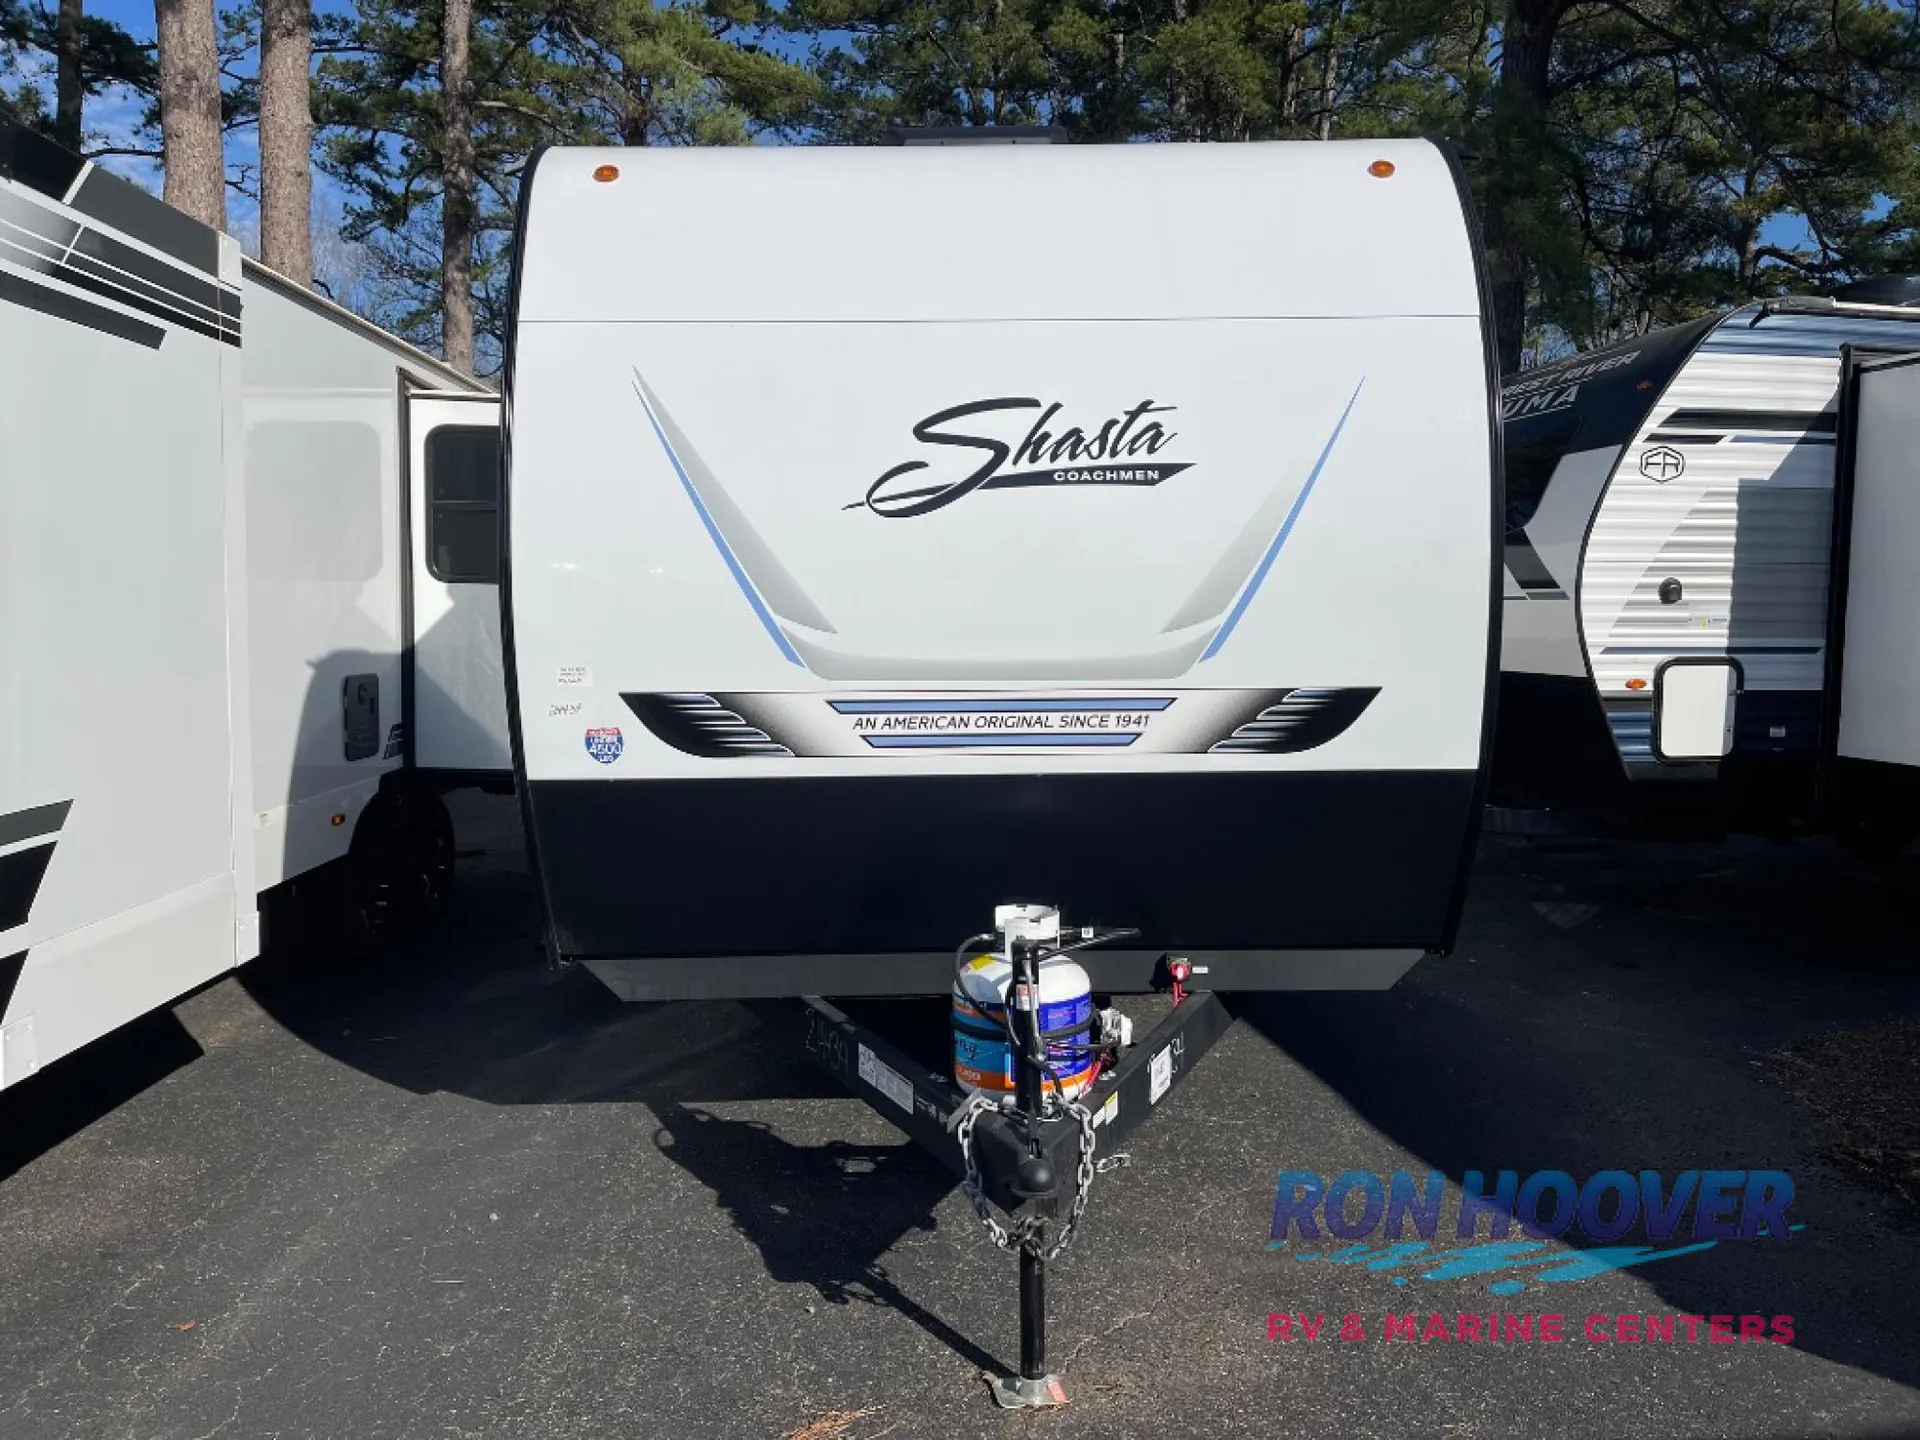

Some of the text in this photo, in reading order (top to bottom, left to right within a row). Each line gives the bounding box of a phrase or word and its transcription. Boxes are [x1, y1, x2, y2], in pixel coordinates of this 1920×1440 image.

[1501, 350, 1641, 397] REST RIVER
[1502, 384, 1580, 418] UMA
[862, 397, 1178, 517] Shasta
[1053, 469, 1160, 482] COACHMEN
[852, 713, 1151, 731] AN AMERICAN ORIGINAL SINCE 1941
